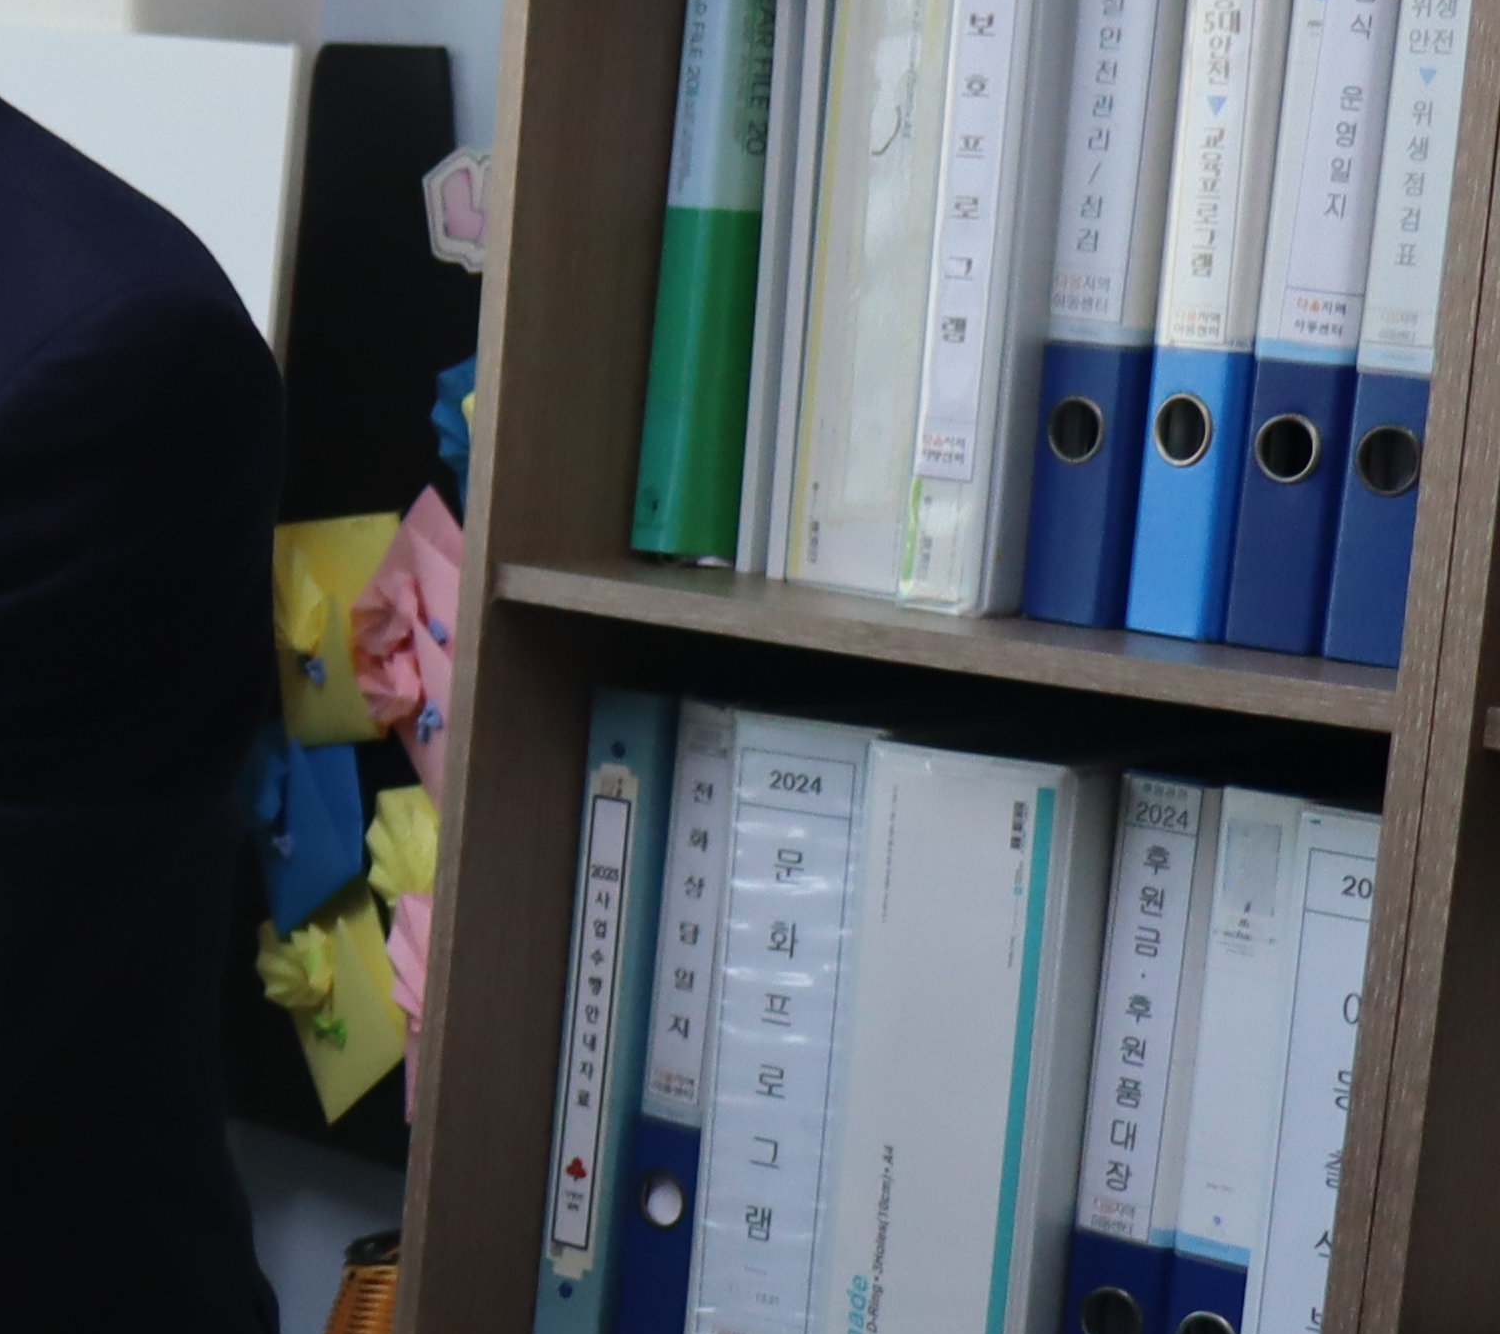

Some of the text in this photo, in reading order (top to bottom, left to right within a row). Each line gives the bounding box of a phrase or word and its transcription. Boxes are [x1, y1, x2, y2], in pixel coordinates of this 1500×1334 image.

[1408, 28, 1454, 56] 안전
[1323, 85, 1363, 220] 운영일지
[1394, 99, 1432, 267] 위생점검표
[768, 770, 824, 797] 2024
[1136, 801, 1188, 829] 2024
[1341, 874, 1374, 900] 20
[745, 849, 804, 1242] 문화프로그램
